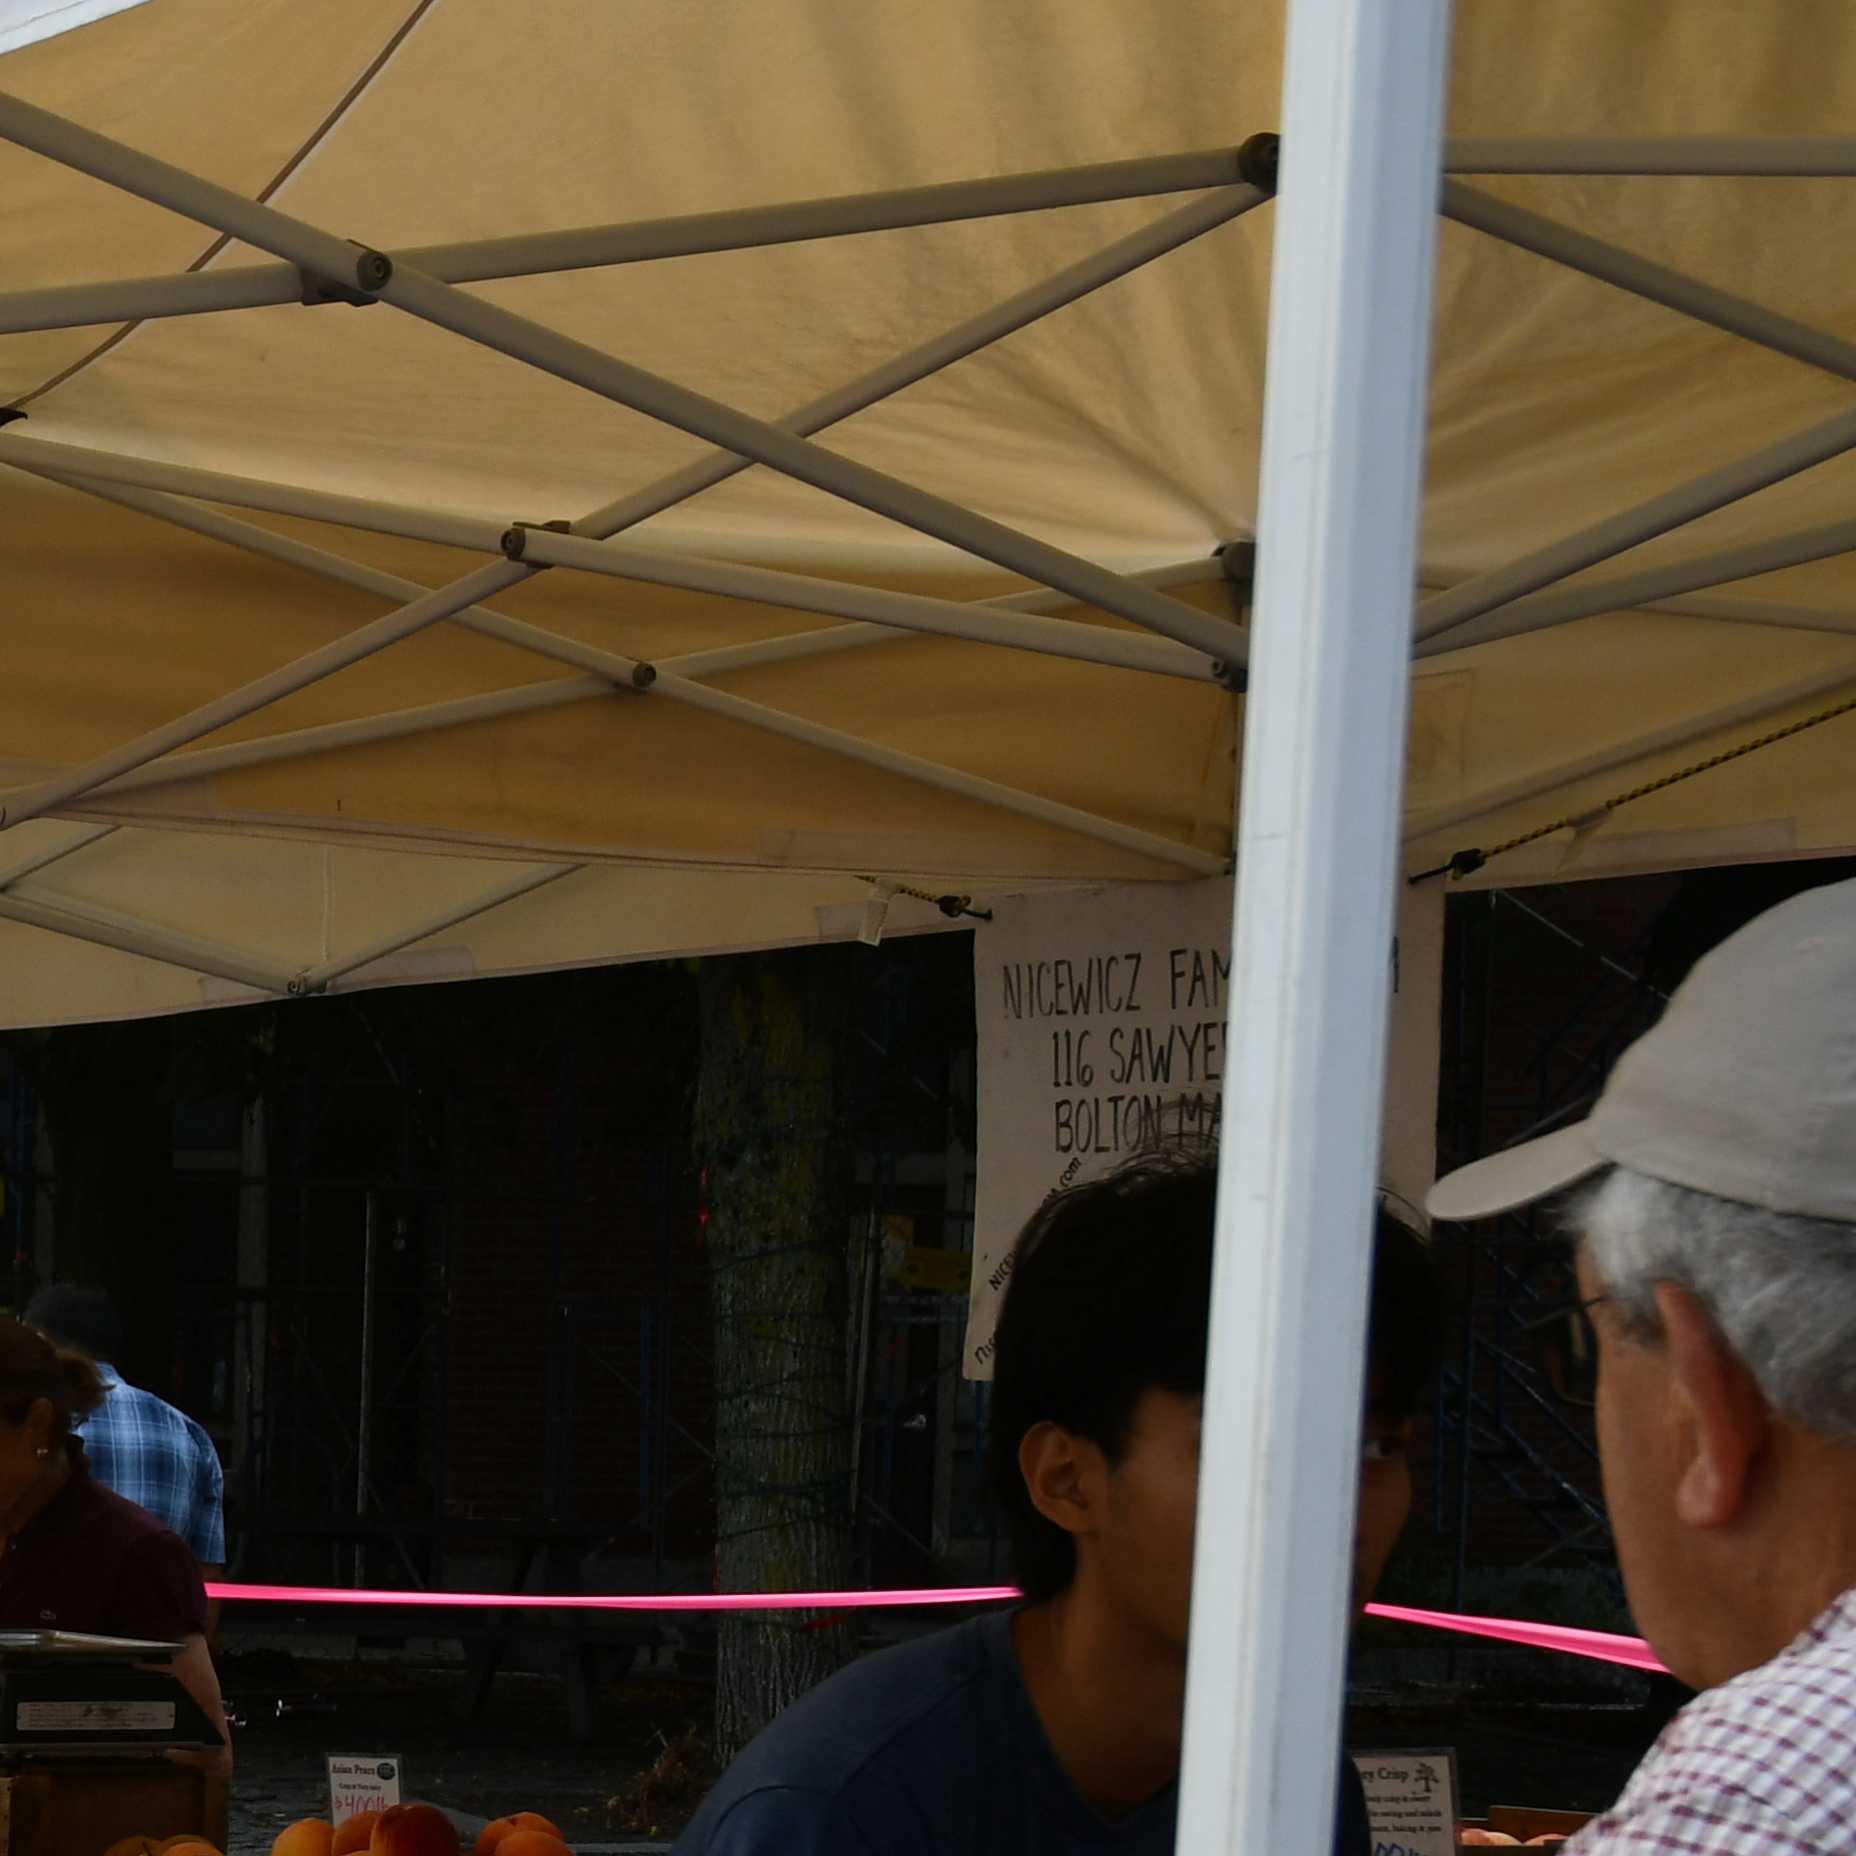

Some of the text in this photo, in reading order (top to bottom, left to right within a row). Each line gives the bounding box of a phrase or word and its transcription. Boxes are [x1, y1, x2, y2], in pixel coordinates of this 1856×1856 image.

[1004, 952, 1142, 1019] NICEWICZ
[1053, 1029, 1095, 1087] 116
[1054, 1093, 1164, 1153] BOLTON
[1377, 1767, 1410, 1783] Crisp
